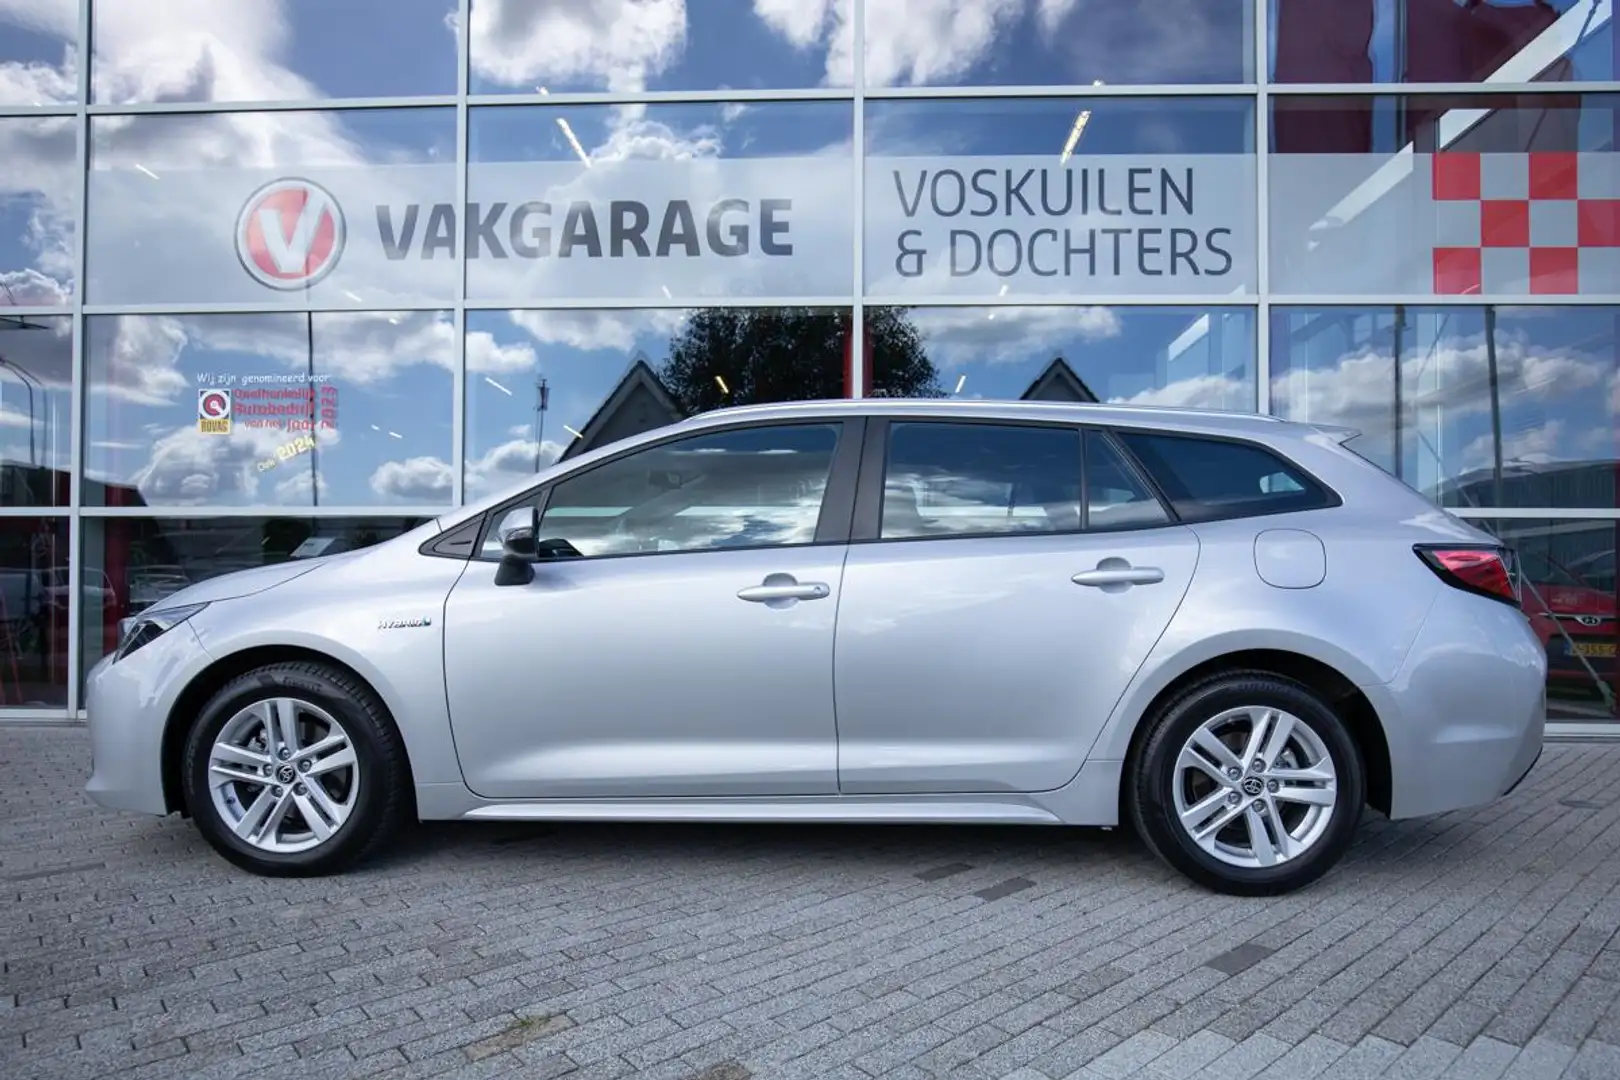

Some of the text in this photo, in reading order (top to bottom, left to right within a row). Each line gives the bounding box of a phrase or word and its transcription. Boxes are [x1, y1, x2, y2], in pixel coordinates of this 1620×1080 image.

[893, 166, 1194, 218] VOSKUILEN
[375, 198, 794, 260] VAKGARAGE
[895, 228, 1233, 278] & DOCHTERS
[196, 372, 330, 386] Wij zijn genomineerd voor
[277, 435, 315, 461] 2024
